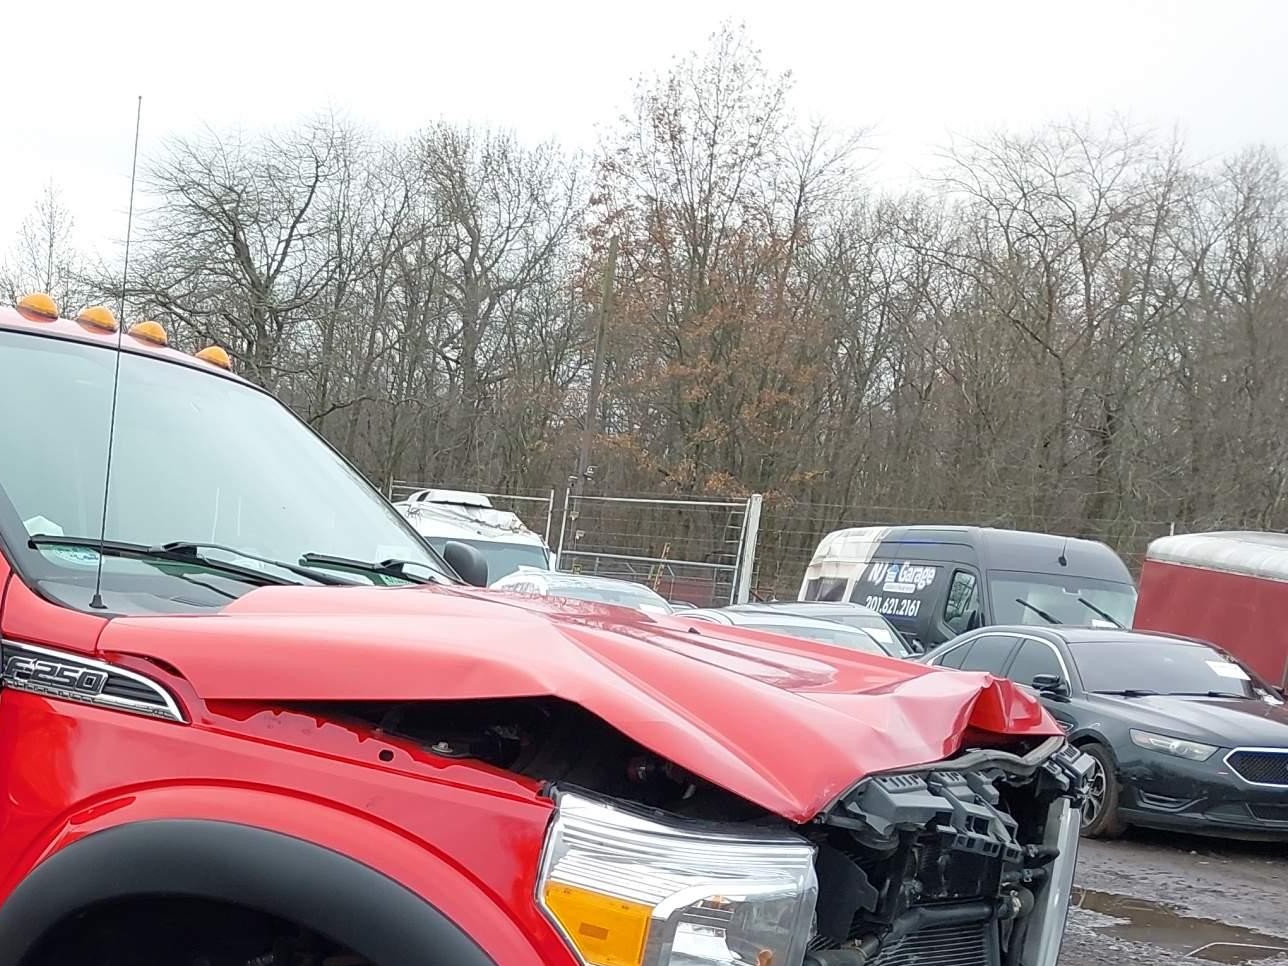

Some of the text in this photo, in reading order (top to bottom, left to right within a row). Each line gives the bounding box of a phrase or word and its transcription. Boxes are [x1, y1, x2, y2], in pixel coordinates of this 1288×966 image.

[867, 562, 937, 590] NJ Garage
[865, 595, 921, 617] 201.621.2161
